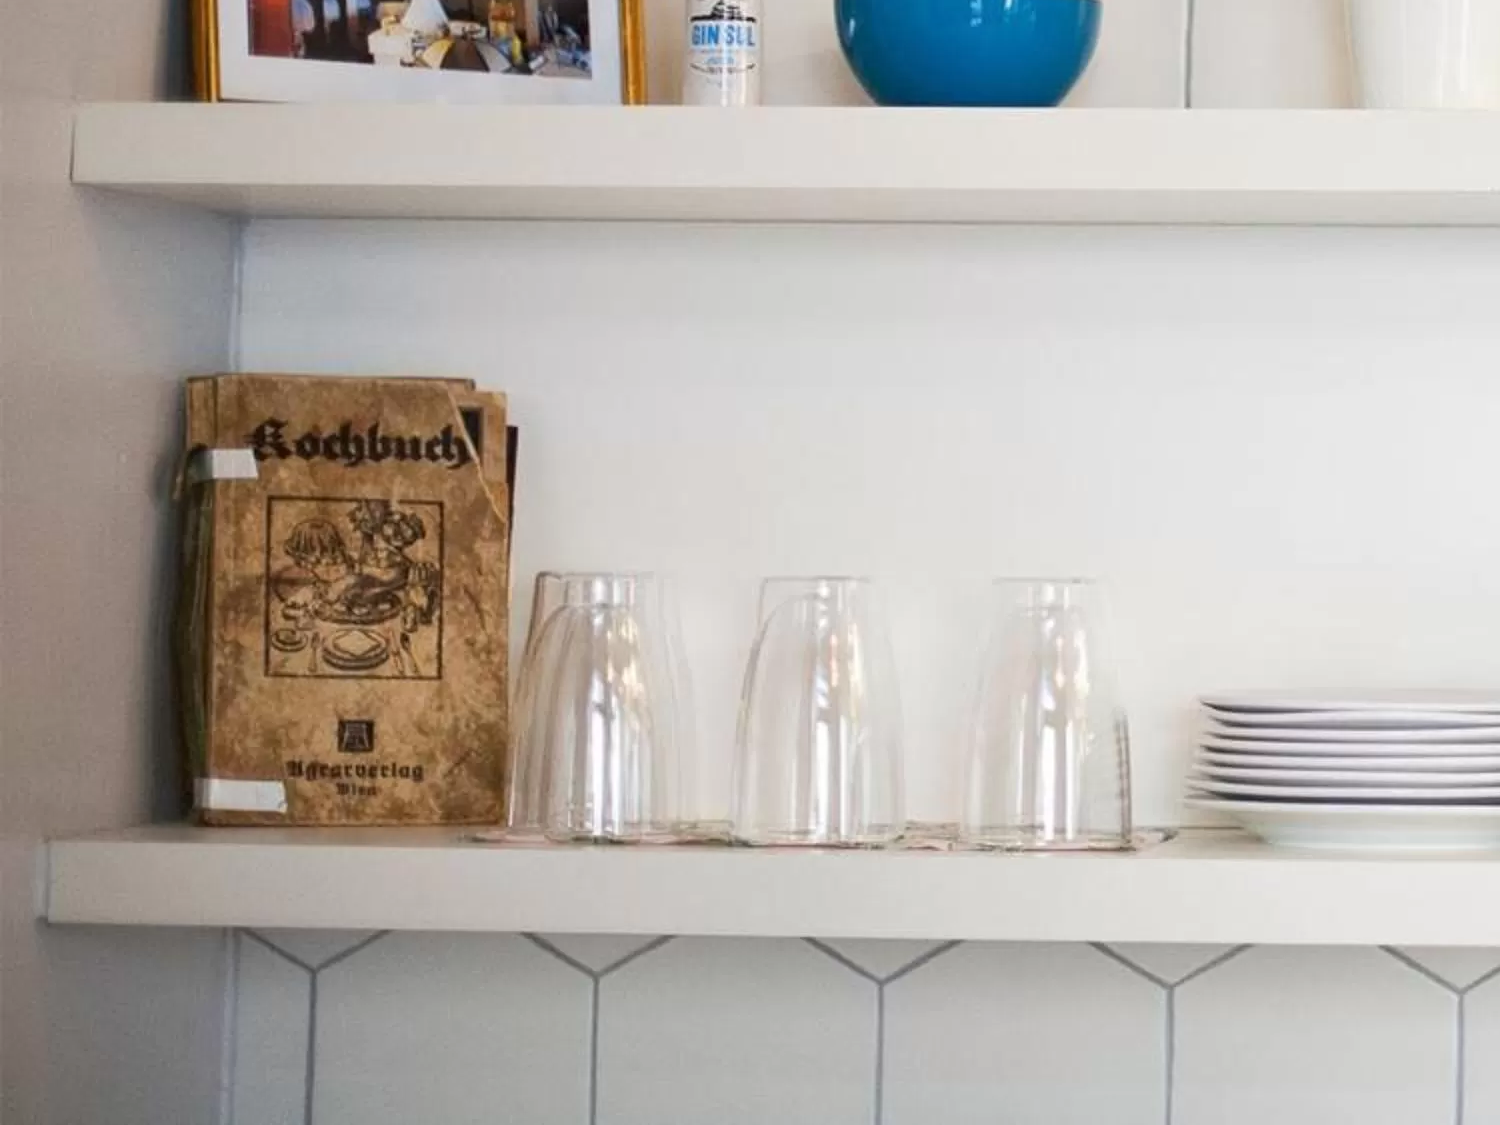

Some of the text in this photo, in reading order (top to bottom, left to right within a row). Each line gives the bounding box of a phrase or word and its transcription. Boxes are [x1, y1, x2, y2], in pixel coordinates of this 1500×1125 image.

[691, 24, 720, 46] GIN
[244, 417, 476, 469] Kochbuch
[285, 759, 425, 783] Agrarverlag
